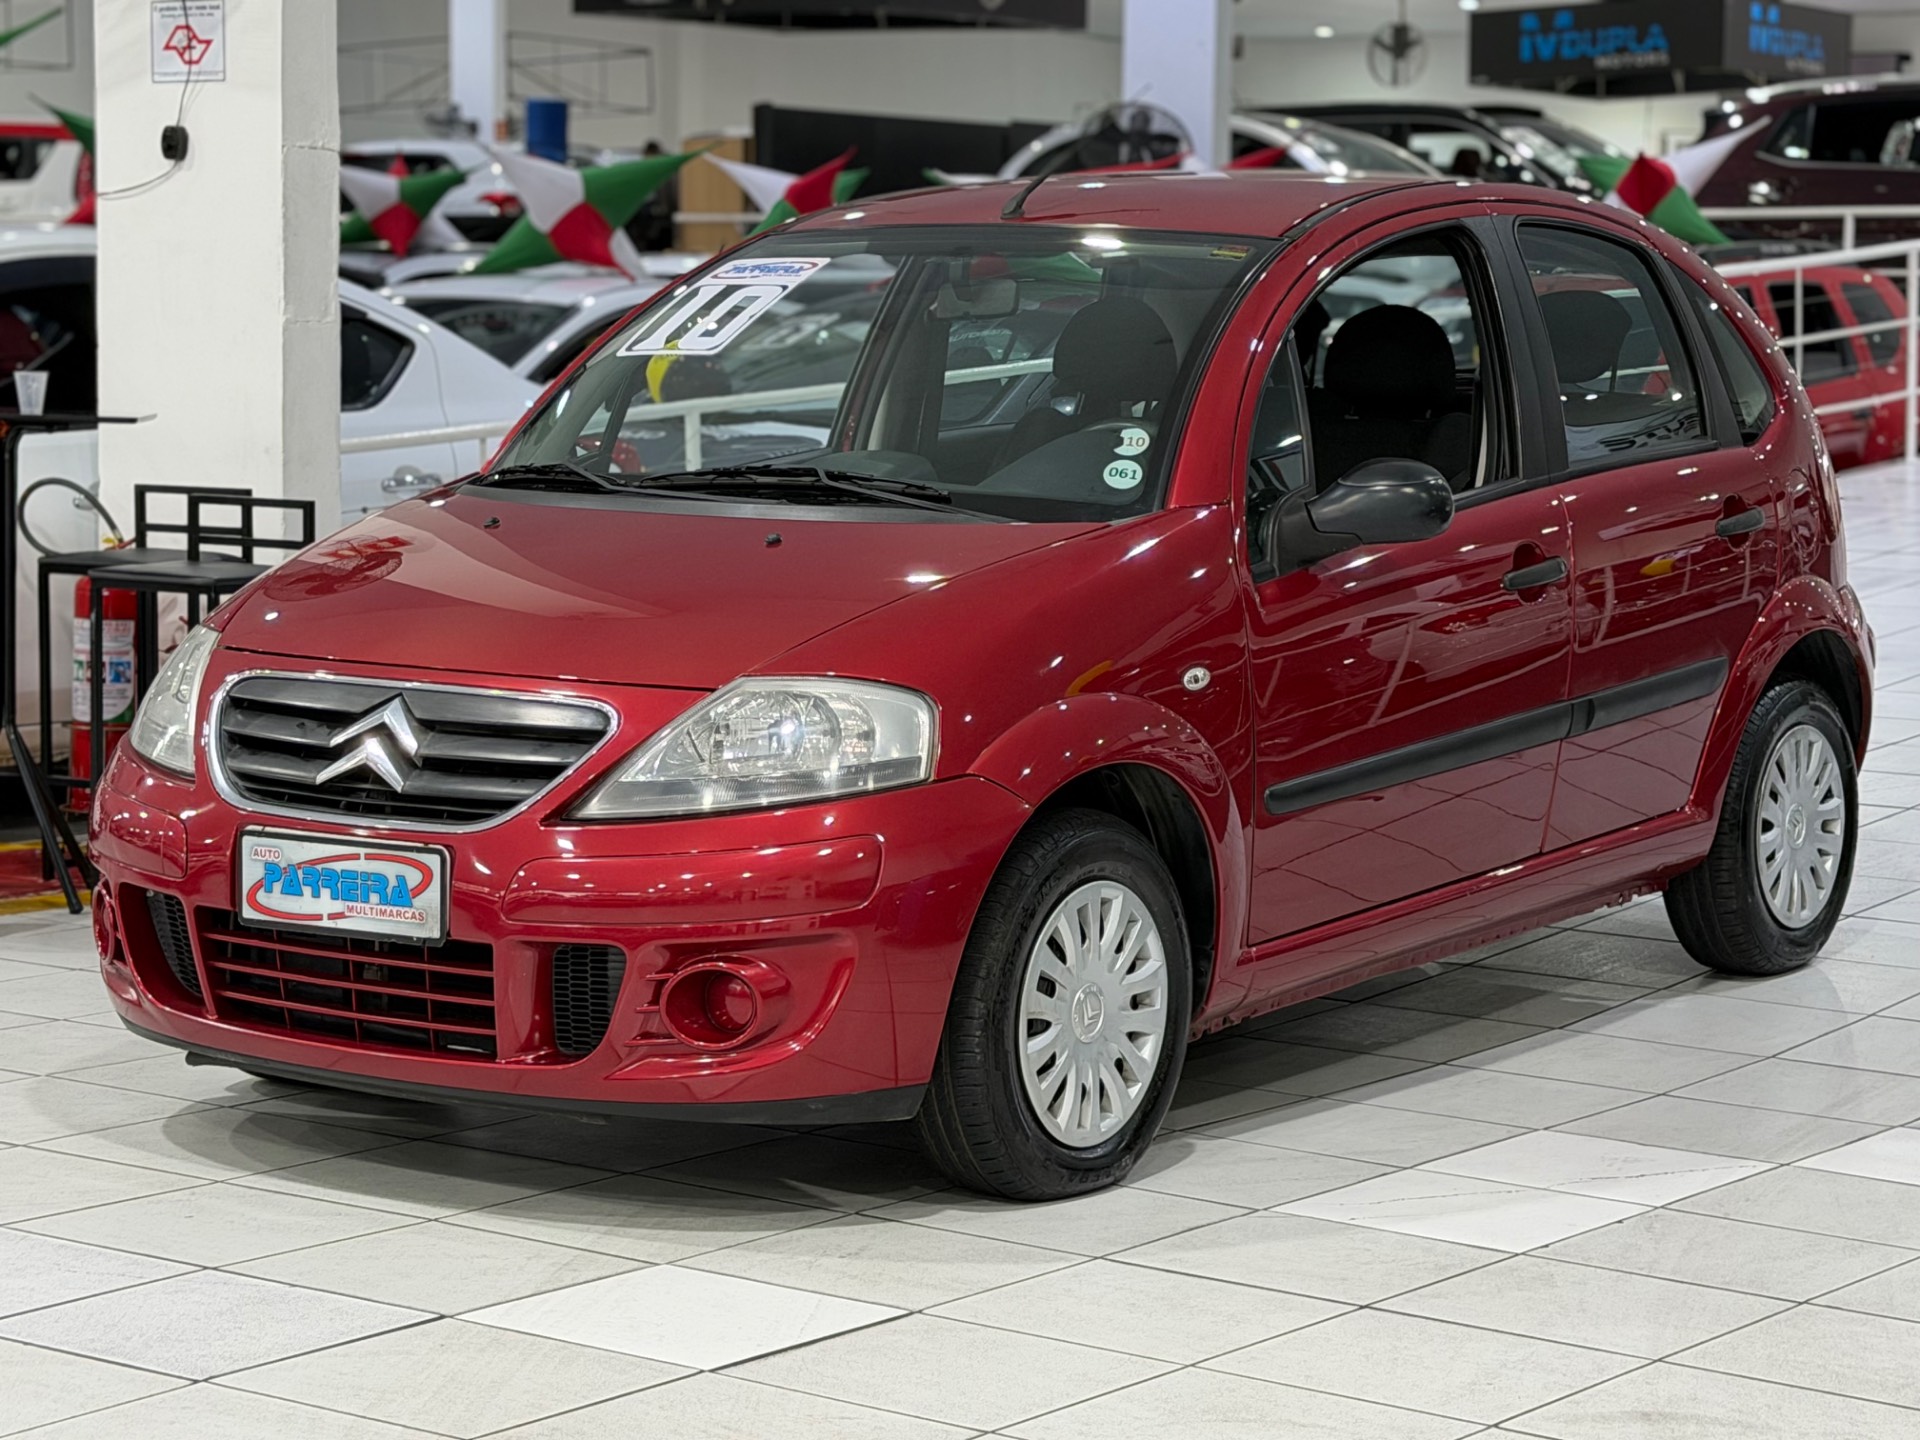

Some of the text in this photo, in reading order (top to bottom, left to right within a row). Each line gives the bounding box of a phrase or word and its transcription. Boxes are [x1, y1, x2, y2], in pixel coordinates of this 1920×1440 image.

[631, 284, 785, 350] 10
[1108, 466, 1138, 481] 061
[252, 847, 281, 860] AUTO
[263, 861, 414, 908] PARREIRA
[345, 903, 426, 922] MULTIMARCAS
